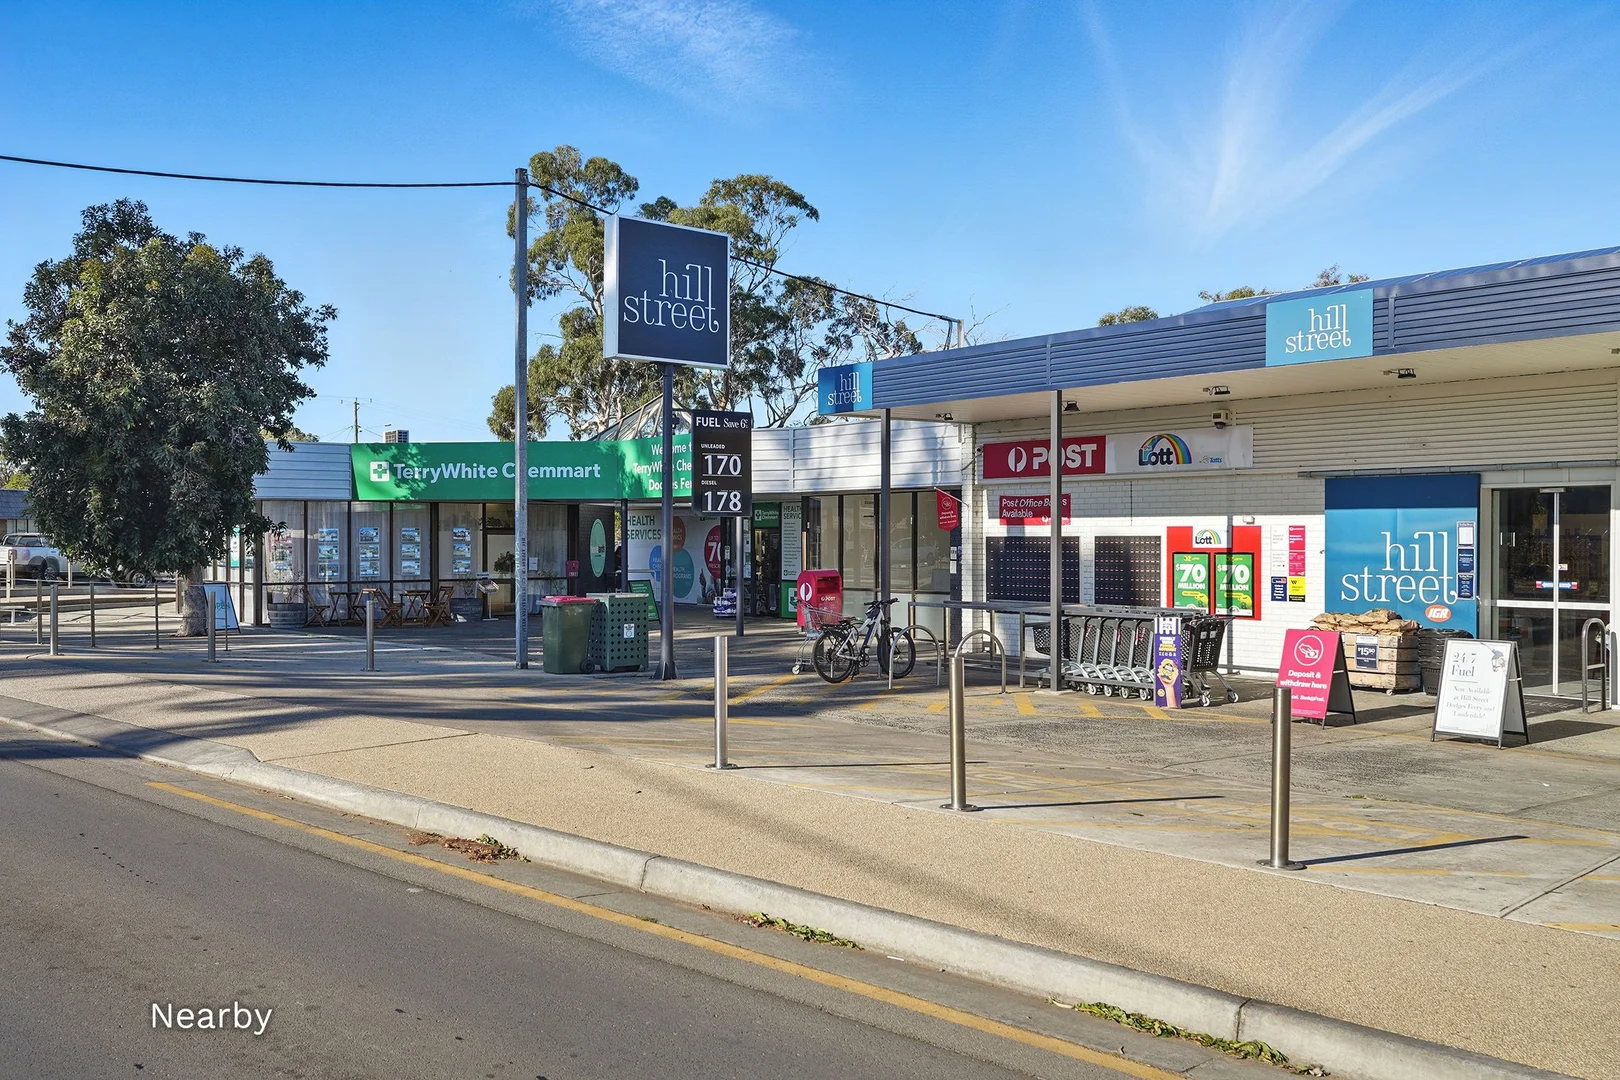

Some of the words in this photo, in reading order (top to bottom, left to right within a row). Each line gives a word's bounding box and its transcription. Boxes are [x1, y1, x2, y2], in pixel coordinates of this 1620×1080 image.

[658, 259, 712, 303] hill
[623, 289, 720, 334] street
[1308, 303, 1347, 333] hill
[1285, 329, 1352, 354] street
[839, 372, 860, 391] hill
[827, 389, 862, 406] street
[695, 416, 721, 428] FUEL
[723, 418, 739, 428] Save
[704, 454, 742, 475] 170
[1138, 447, 1174, 466] Lott
[393, 462, 498, 484] TerryWhite
[501, 462, 601, 479] Cemmart
[704, 490, 742, 512] 178
[1002, 498, 1019, 507] Post
[1019, 498, 1042, 508] Office
[1001, 509, 1033, 518] Available
[627, 529, 662, 540] SERVICES
[1195, 536, 1212, 545] Lott
[1381, 531, 1449, 573] hill
[1175, 563, 1207, 584] $70
[1217, 564, 1250, 585] $70
[1177, 582, 1206, 590] MILLION
[1219, 583, 1249, 592] MILLION
[1340, 565, 1458, 605] street
[1427, 608, 1450, 619] IGA
[1288, 669, 1315, 679] Deposit
[1451, 664, 1475, 677] Fuel
[1280, 679, 1311, 688] withdraw
[1311, 681, 1328, 690] here
